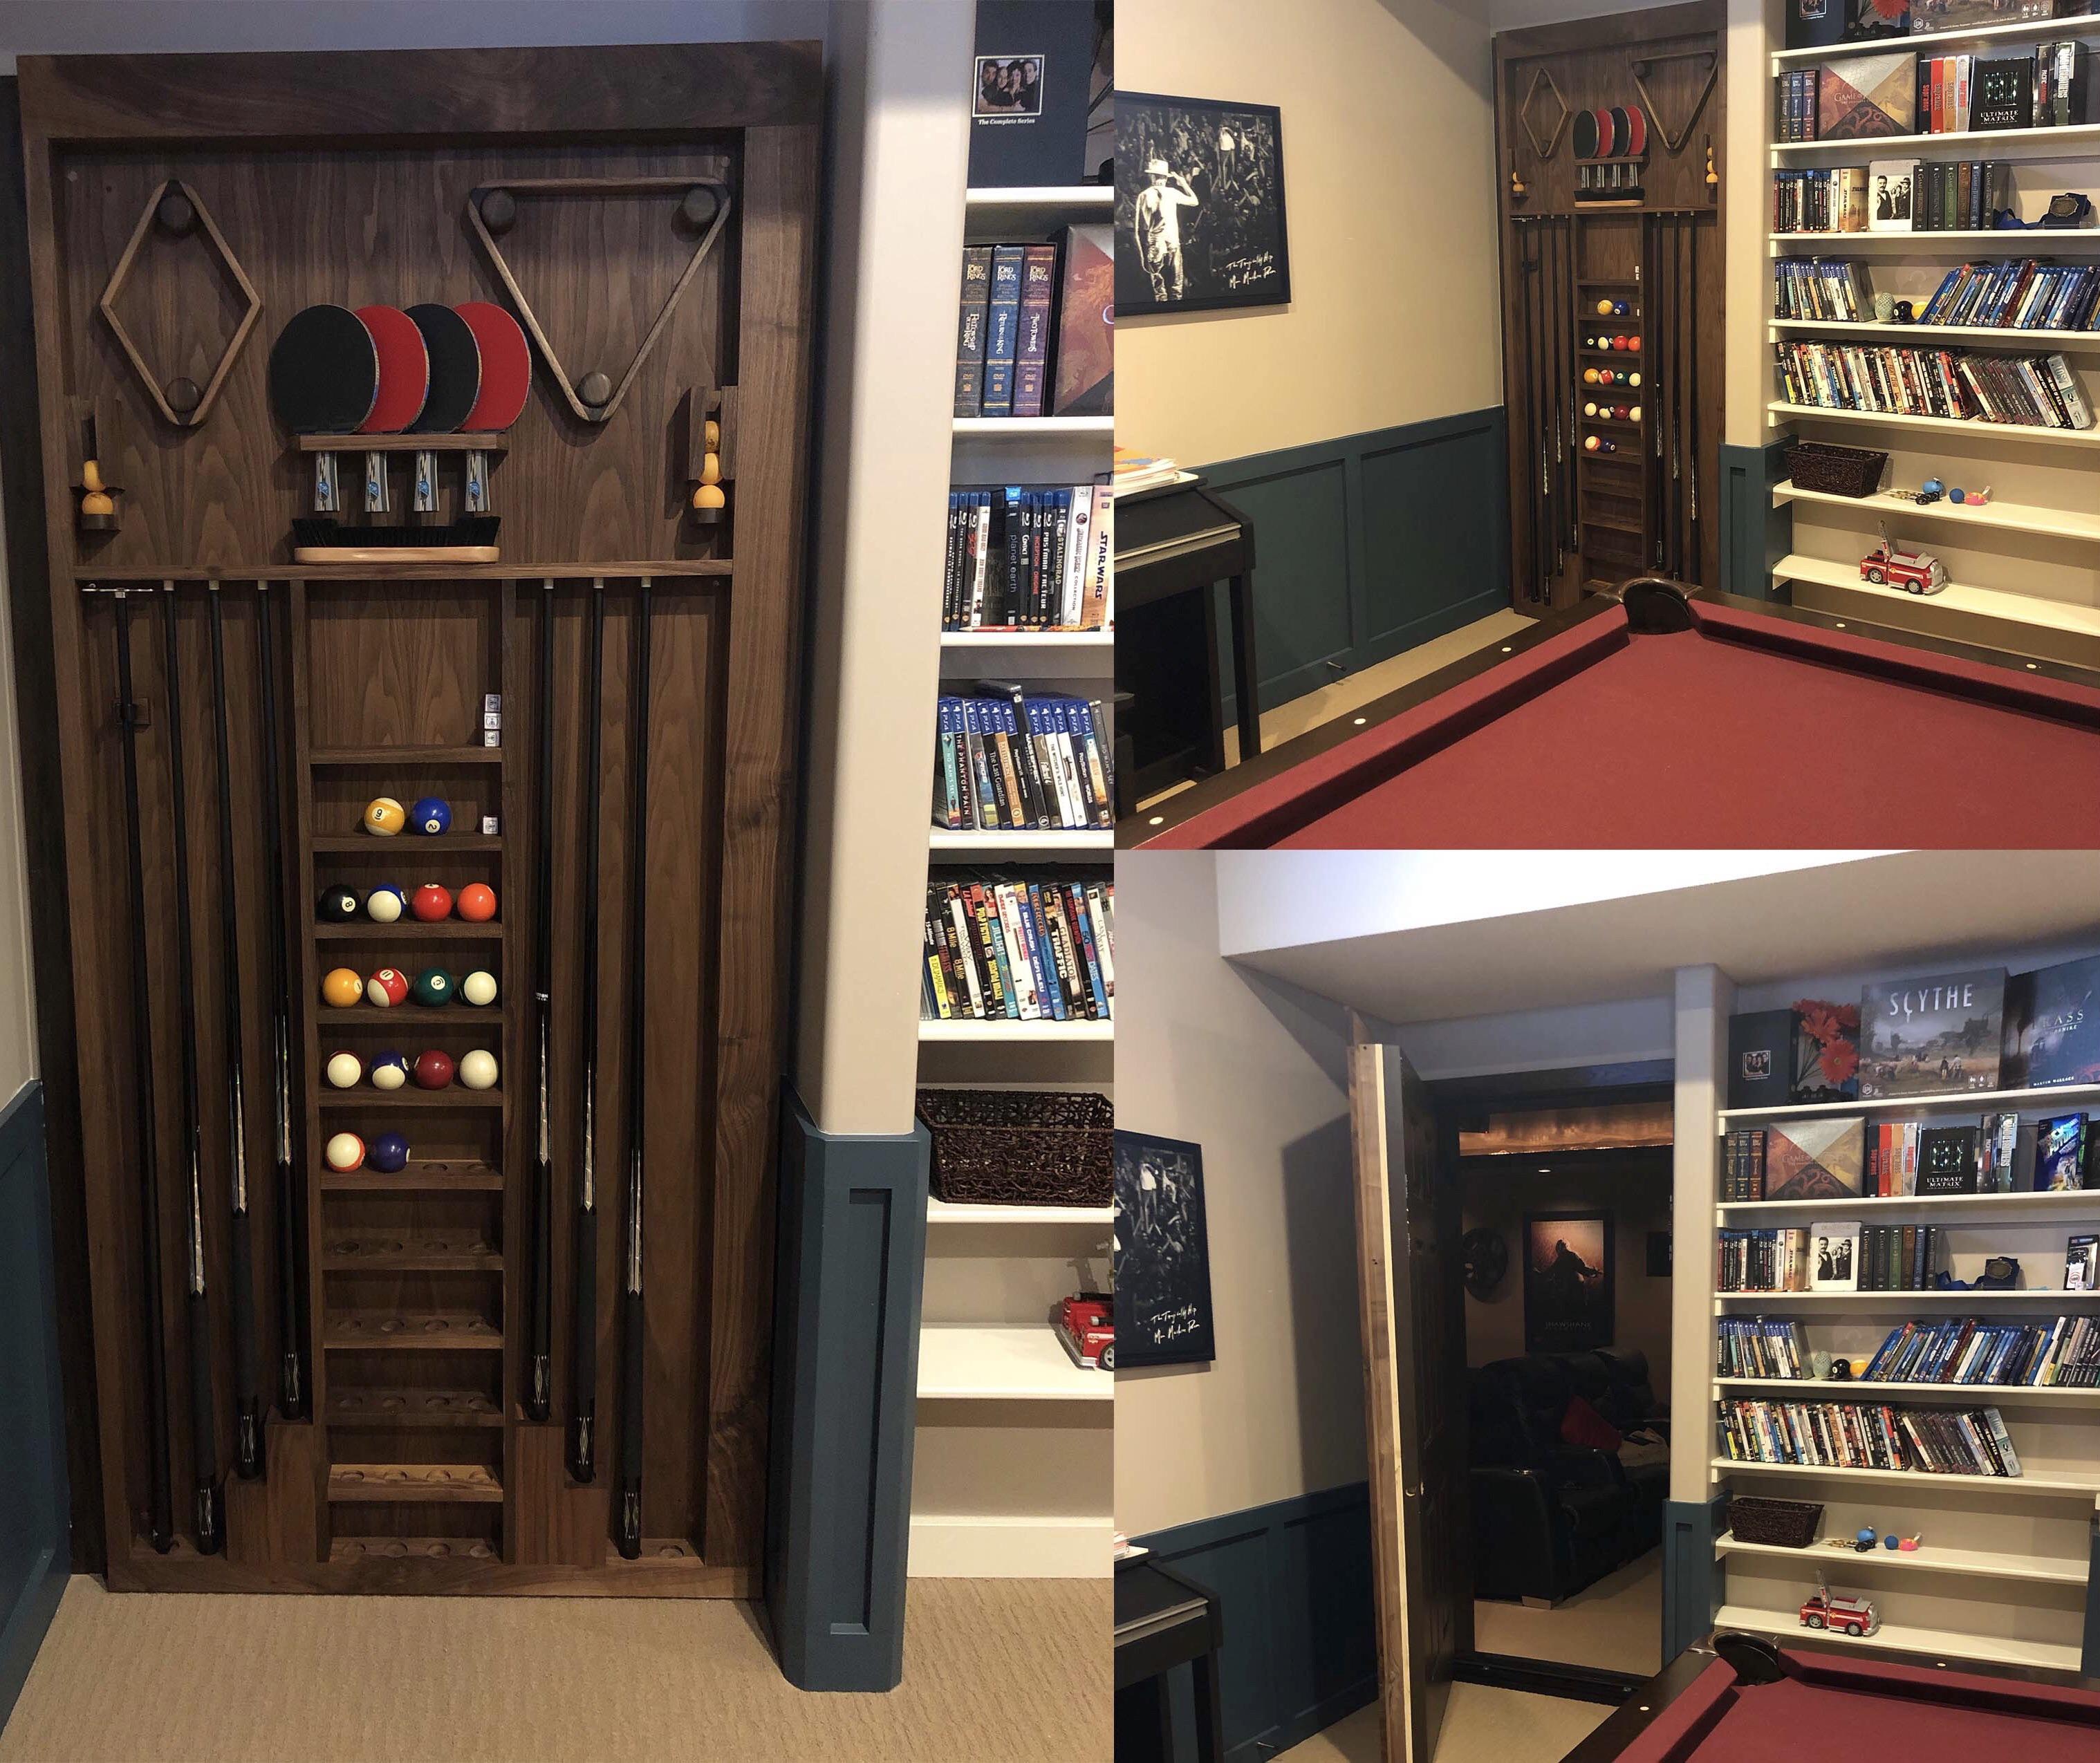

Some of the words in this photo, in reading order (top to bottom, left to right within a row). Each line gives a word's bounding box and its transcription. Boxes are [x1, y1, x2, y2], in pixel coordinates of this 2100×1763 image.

[2058, 71, 2069, 98] BROTHERS
[1980, 109, 2019, 118] ULTIMATE
[967, 264, 983, 273] LORD
[997, 265, 1014, 274] LORD
[1030, 265, 1046, 274] LORD
[1028, 328, 1038, 352] TOWERS
[2055, 365, 2068, 384] LOST
[1010, 534, 1018, 566] planet
[1097, 531, 1108, 565] STAR
[1055, 537, 1065, 585] STALINGRAD
[1095, 566, 1106, 600] WARS
[946, 753, 951, 762] NO
[1025, 734, 1034, 756] MASS
[1030, 756, 1040, 784] EFFECT
[1079, 752, 1088, 778] PlayStation
[958, 752, 967, 792] PHANTOM
[992, 764, 1000, 776] Last
[1041, 762, 1051, 779] Fallout
[994, 778, 1005, 807] Guardian
[976, 906, 987, 922] PULP
[1023, 912, 1031, 929] BLUE
[948, 933, 957, 948] Mile
[979, 922, 992, 945] FICTION
[992, 926, 1005, 955] JILLIAN
[1026, 929, 1036, 951] CRUSH
[1052, 929, 1068, 979] TRAFFIC
[1060, 926, 1076, 981] GLADIATOR
[1082, 931, 1090, 944] 50
[1088, 962, 1099, 982] DATES
[931, 962, 944, 994] DUMMIES
[956, 965, 965, 980] Mile
[1036, 973, 1045, 993] BLEU
[1890, 984, 1973, 1023] SCYTHE
[2000, 1141, 2011, 1166] BROTHERS
